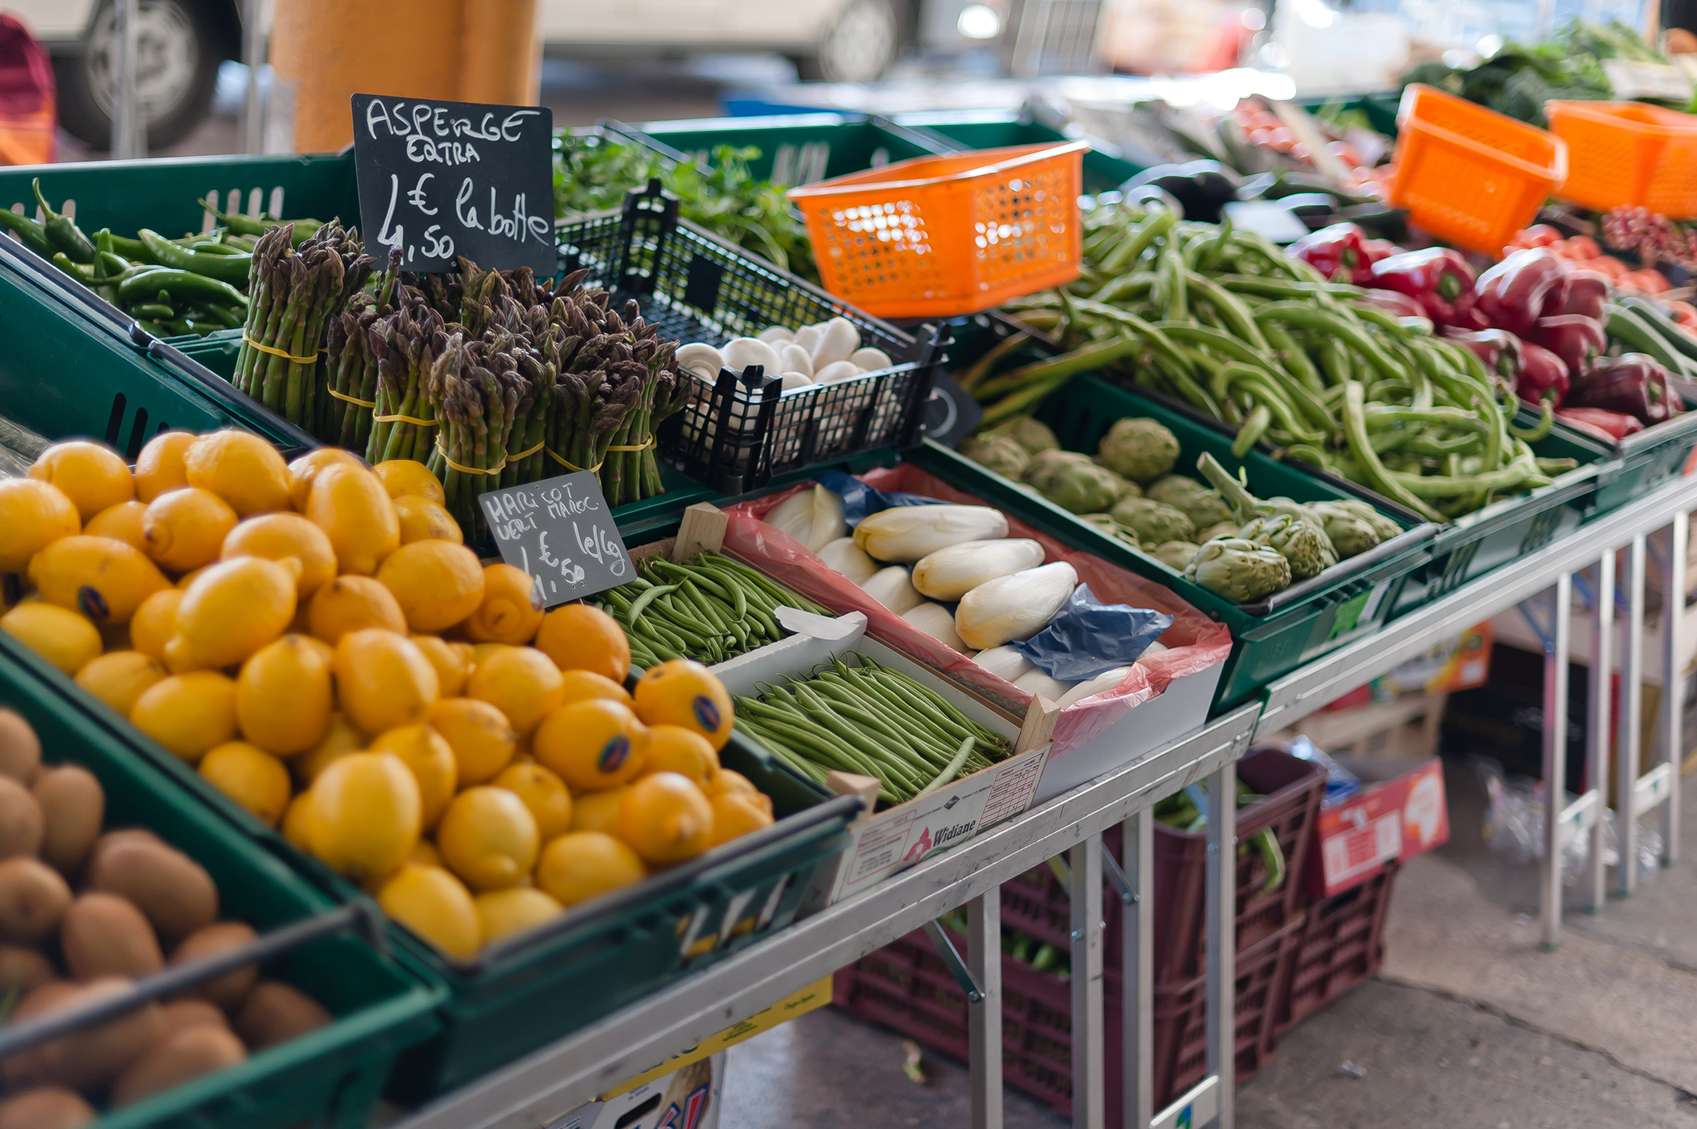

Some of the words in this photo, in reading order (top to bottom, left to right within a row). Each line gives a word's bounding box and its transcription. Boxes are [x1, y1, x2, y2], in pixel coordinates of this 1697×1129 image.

[366, 98, 541, 142] ASPERGE
[455, 176, 485, 231] la
[487, 185, 551, 247] botte
[496, 511, 538, 541] VERT
[932, 820, 977, 847] Widiane
